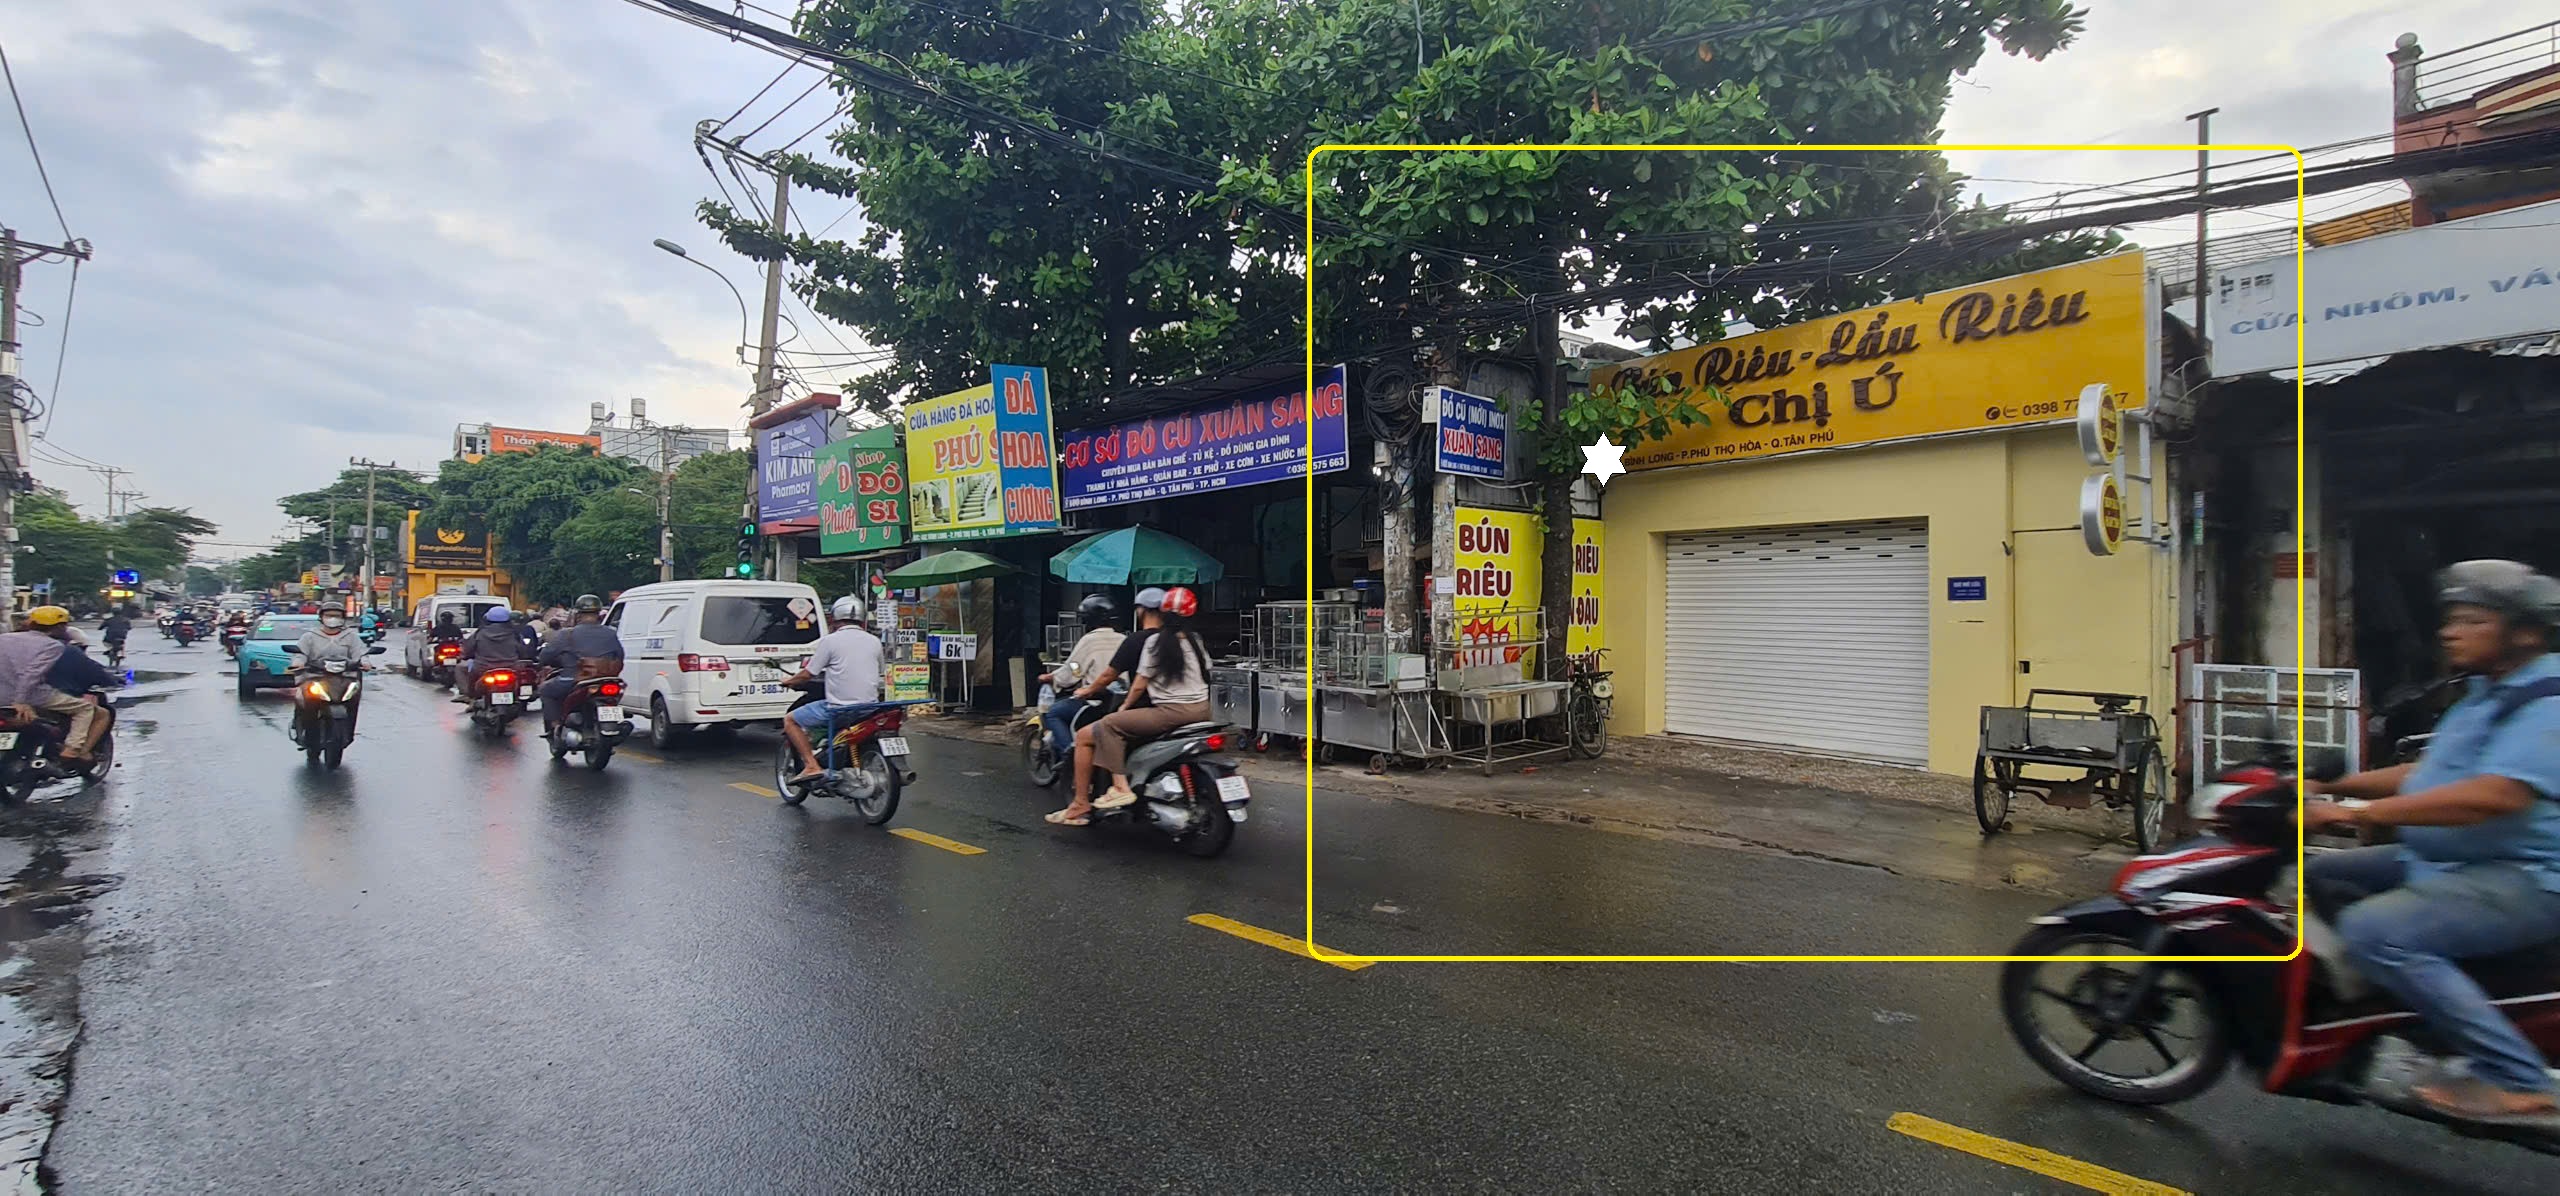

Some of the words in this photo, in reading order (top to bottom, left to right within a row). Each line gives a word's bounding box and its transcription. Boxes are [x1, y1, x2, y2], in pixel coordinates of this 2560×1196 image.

[2324, 286, 2471, 321] NHÔM,
[1694, 345, 1796, 387] Riêu
[1940, 287, 2090, 344] Riêu
[1004, 371, 1037, 415] ĐÁ
[1729, 381, 1833, 427] Chị
[1852, 361, 1904, 411] Ú
[2022, 400, 2058, 416] 0398
[909, 408, 929, 431] CỬA
[930, 404, 957, 428] HÀNG
[959, 398, 973, 419] ĐÁ
[1199, 399, 1265, 444] XUÂN
[1271, 383, 1343, 429] SANG
[1489, 411, 1505, 431] INOX
[855, 450, 886, 468] Shop
[933, 424, 983, 474] PHÚ
[1001, 431, 1049, 468] HOA
[1233, 440, 1254, 454] DÙNG
[1256, 438, 1269, 449] GIA
[1270, 434, 1290, 446] ĐÌNH
[1443, 424, 1474, 457] XUÂN
[1475, 434, 1502, 463] SANG
[1624, 454, 1645, 467] BÌNH
[1648, 452, 1674, 464] LONG
[1714, 445, 1736, 458] THỌ
[1739, 438, 1762, 452] HÒA
[1810, 428, 1835, 444] PHÚ
[765, 457, 787, 484] KIM
[790, 450, 816, 478] ANH
[857, 461, 904, 495] ĐỒ
[1172, 468, 1187, 478] BAR
[1193, 466, 1202, 476] XE
[1225, 460, 1235, 470] XE
[1260, 454, 1271, 464] XE
[1211, 477, 1227, 486] HCM
[771, 481, 811, 499] Pharmacy
[867, 499, 901, 524] SI
[1458, 516, 1511, 556] BÚN
[1575, 536, 1600, 575] RIÊU
[1455, 561, 1513, 598] RIÊU
[1576, 588, 1600, 633] ĐẬU
